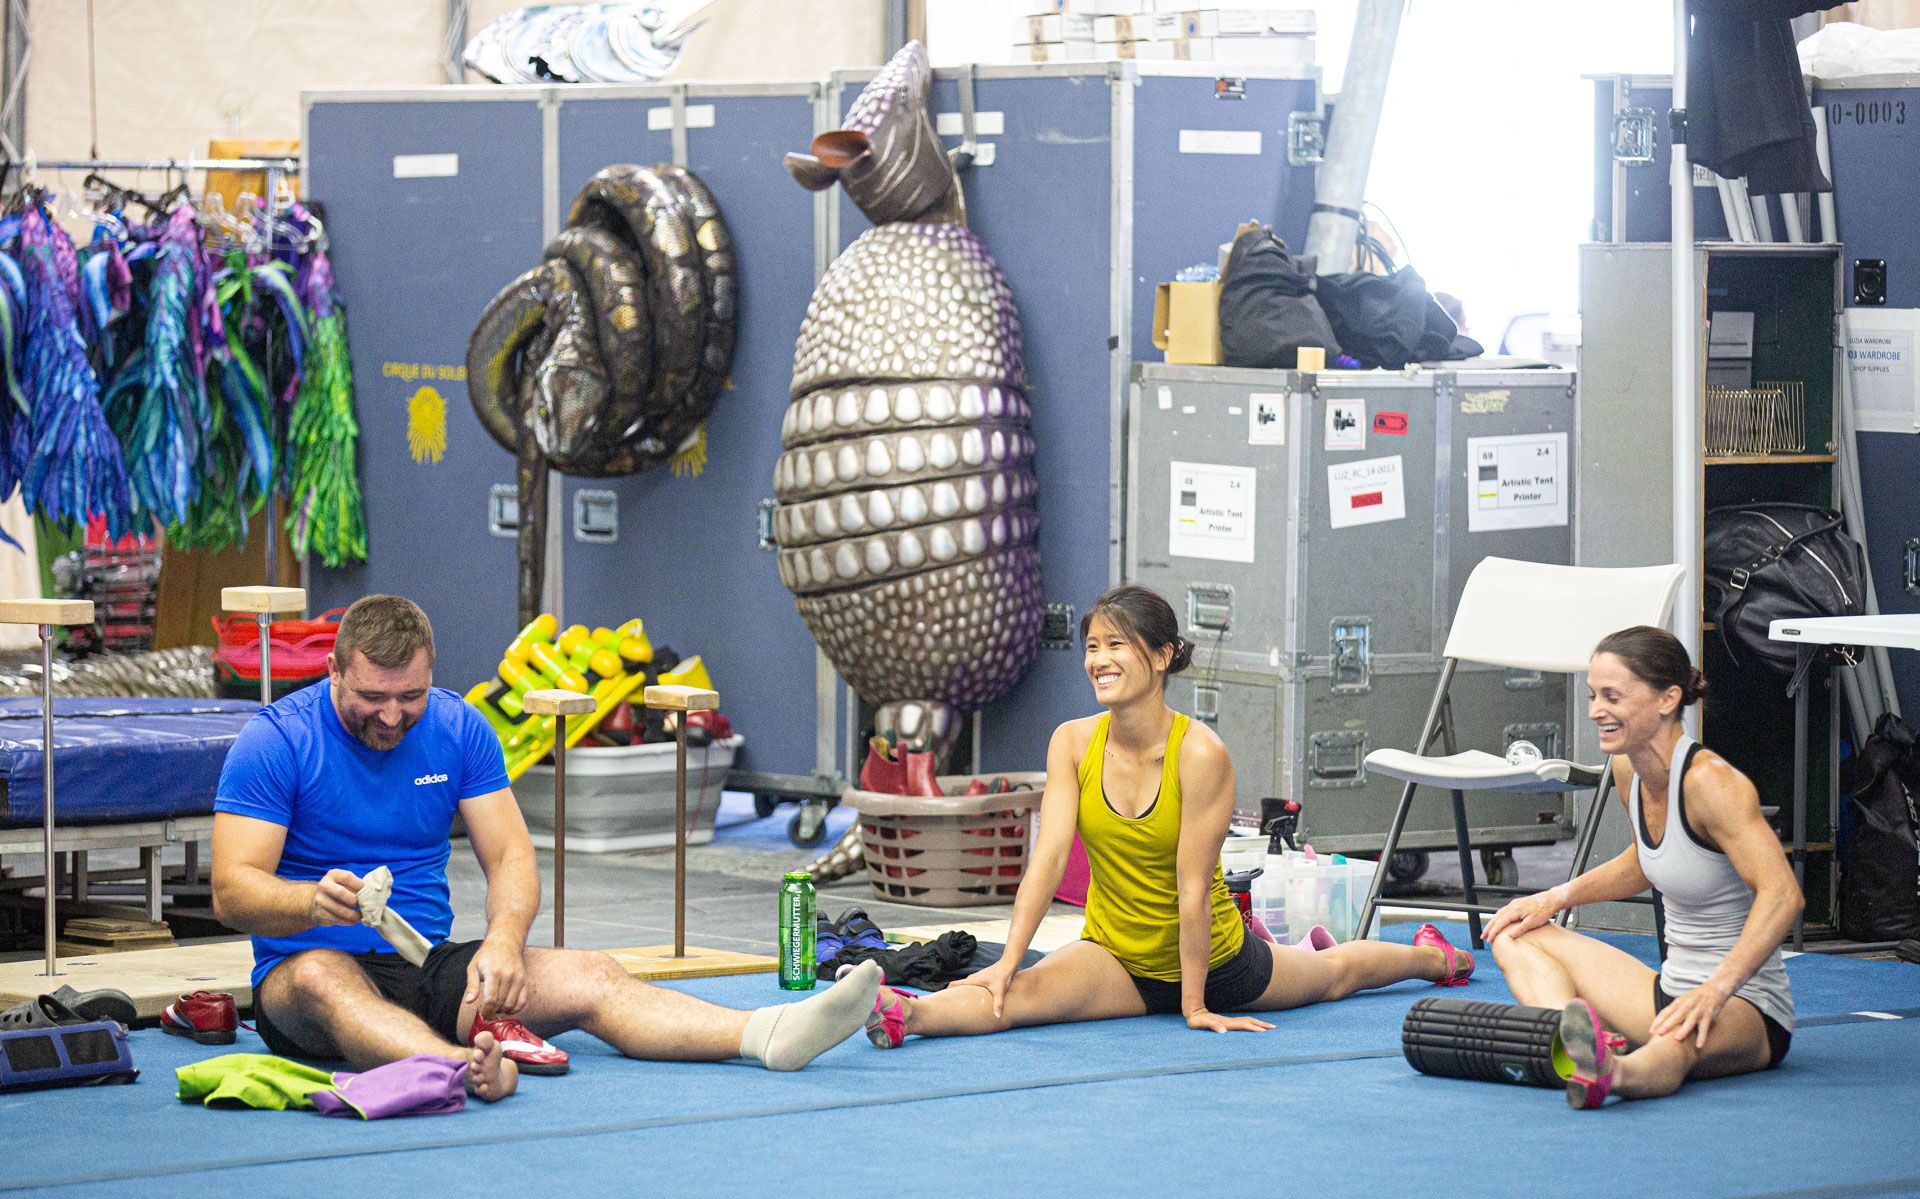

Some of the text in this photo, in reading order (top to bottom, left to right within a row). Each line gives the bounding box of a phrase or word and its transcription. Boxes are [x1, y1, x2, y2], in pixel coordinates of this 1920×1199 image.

[1859, 350, 1901, 361] WARDROBE
[1536, 447, 1550, 457] 2.4
[1229, 480, 1241, 489] 2.4
[1501, 475, 1554, 487] Artistic Tent
[1513, 492, 1542, 502] Printer
[1200, 507, 1243, 519] Artistic Tent
[1208, 522, 1233, 533] Printer
[414, 773, 449, 786] adidas
